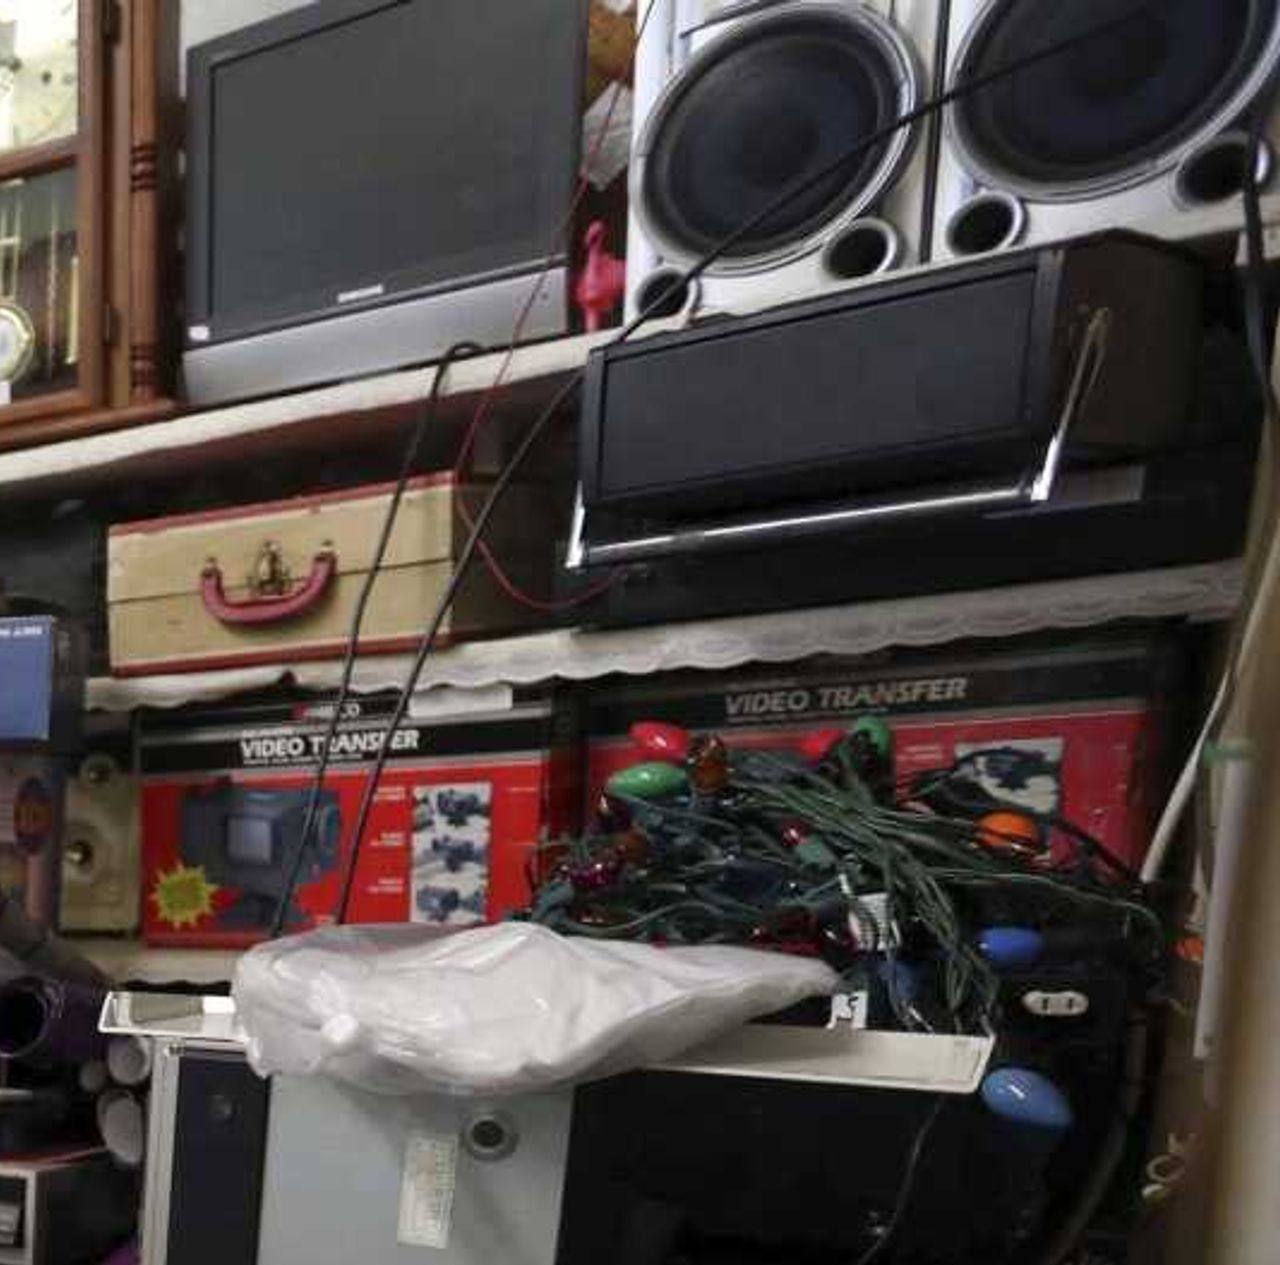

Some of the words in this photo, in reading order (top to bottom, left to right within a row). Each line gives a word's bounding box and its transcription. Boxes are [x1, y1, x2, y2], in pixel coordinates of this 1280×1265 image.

[724, 689, 810, 716] VIDEO
[818, 677, 970, 710] TRANSFER
[240, 735, 304, 759] VIDEO
